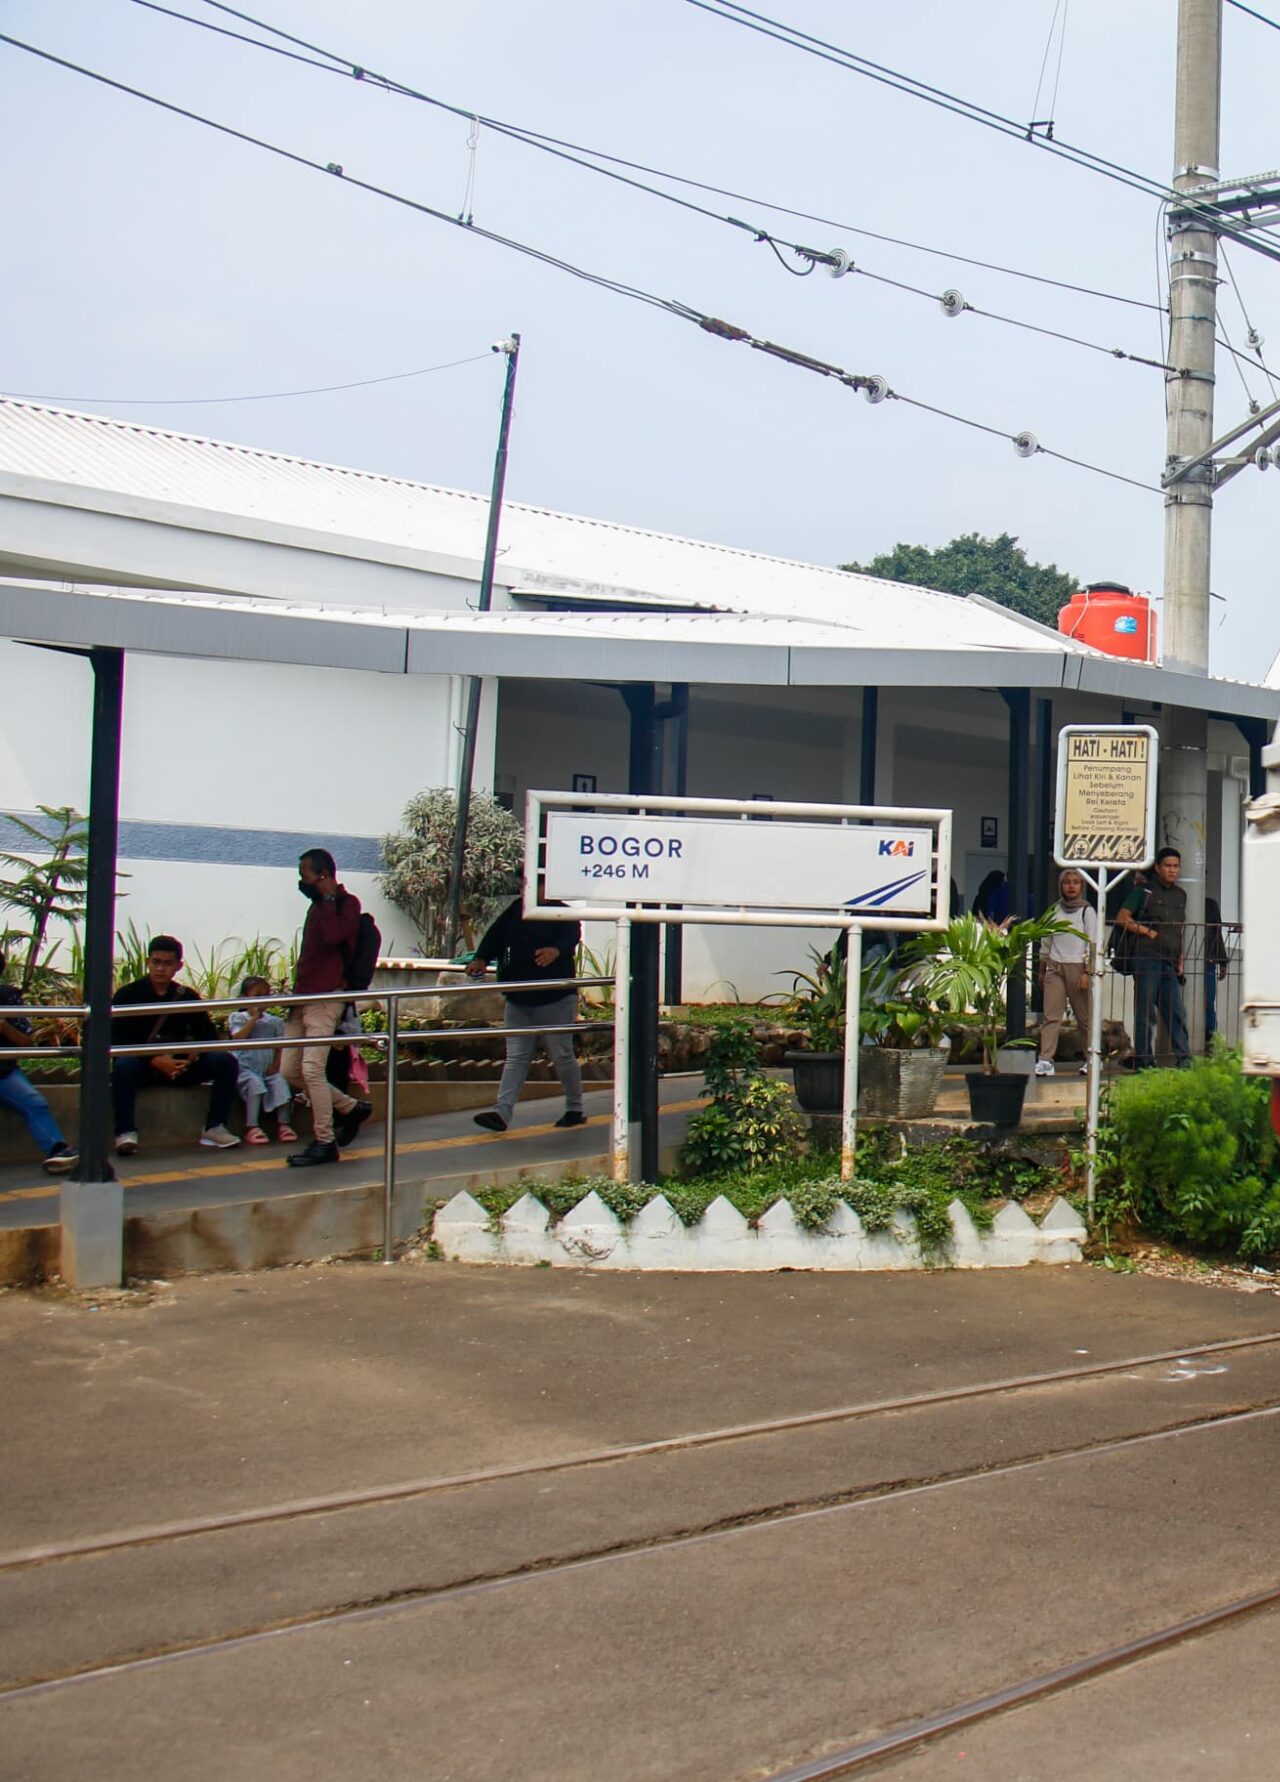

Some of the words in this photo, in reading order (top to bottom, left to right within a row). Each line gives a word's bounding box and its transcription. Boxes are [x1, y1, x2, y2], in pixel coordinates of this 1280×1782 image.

[1073, 739, 1100, 757] HATI
[1110, 740, 1137, 758] HATI
[1083, 764, 1132, 773] Penumpang
[1073, 772, 1092, 780] Lihat
[1079, 789, 1134, 799] Menyeberang
[1100, 798, 1126, 806] Kereta
[580, 835, 682, 858] BOGOR
[581, 863, 626, 878] +246
[632, 863, 649, 878] M
